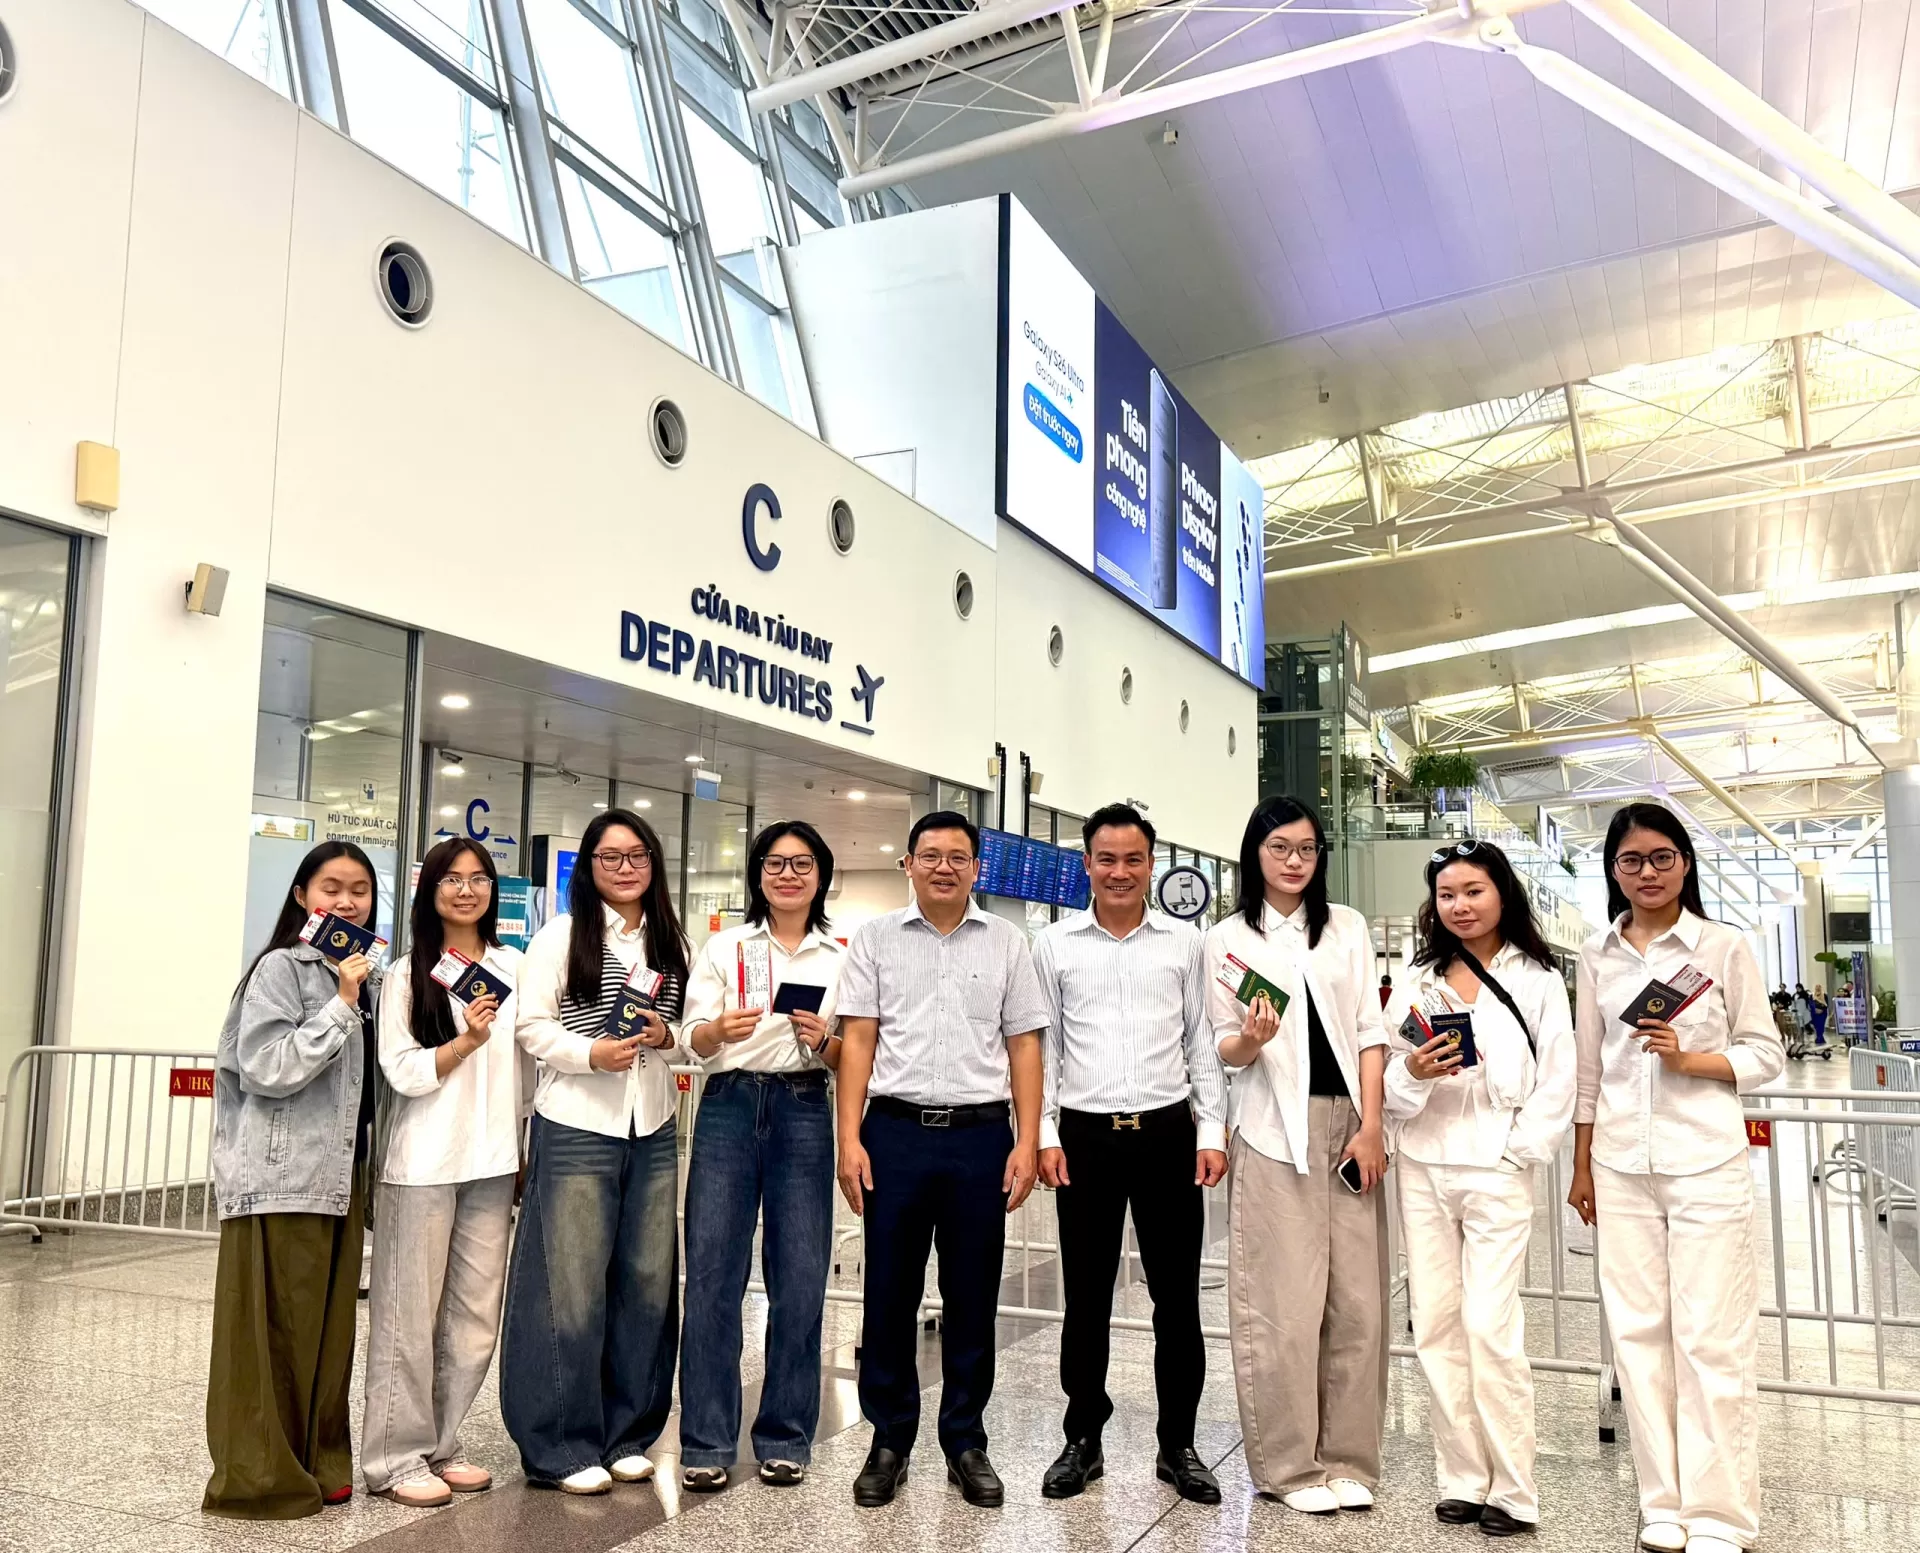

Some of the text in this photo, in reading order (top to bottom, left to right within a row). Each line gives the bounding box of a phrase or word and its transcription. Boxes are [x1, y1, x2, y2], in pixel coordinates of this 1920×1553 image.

[1023, 320, 1085, 394] Galaxy S26 Ultra
[1035, 360, 1060, 397] Galaxy
[1061, 426, 1080, 455] ngay
[1121, 398, 1147, 452] Tiên
[1106, 432, 1147, 501] phong
[1181, 461, 1217, 528] Privacy
[742, 482, 782, 572] C
[1182, 499, 1217, 563] Display
[691, 583, 833, 664] CỬA RA TÀU BAY
[620, 610, 833, 722] DEPARTURES
[362, 834, 397, 848] Immigrat
[386, 819, 397, 830] CẢ
[466, 798, 490, 842] C
[173, 1076, 212, 1090] AHK
